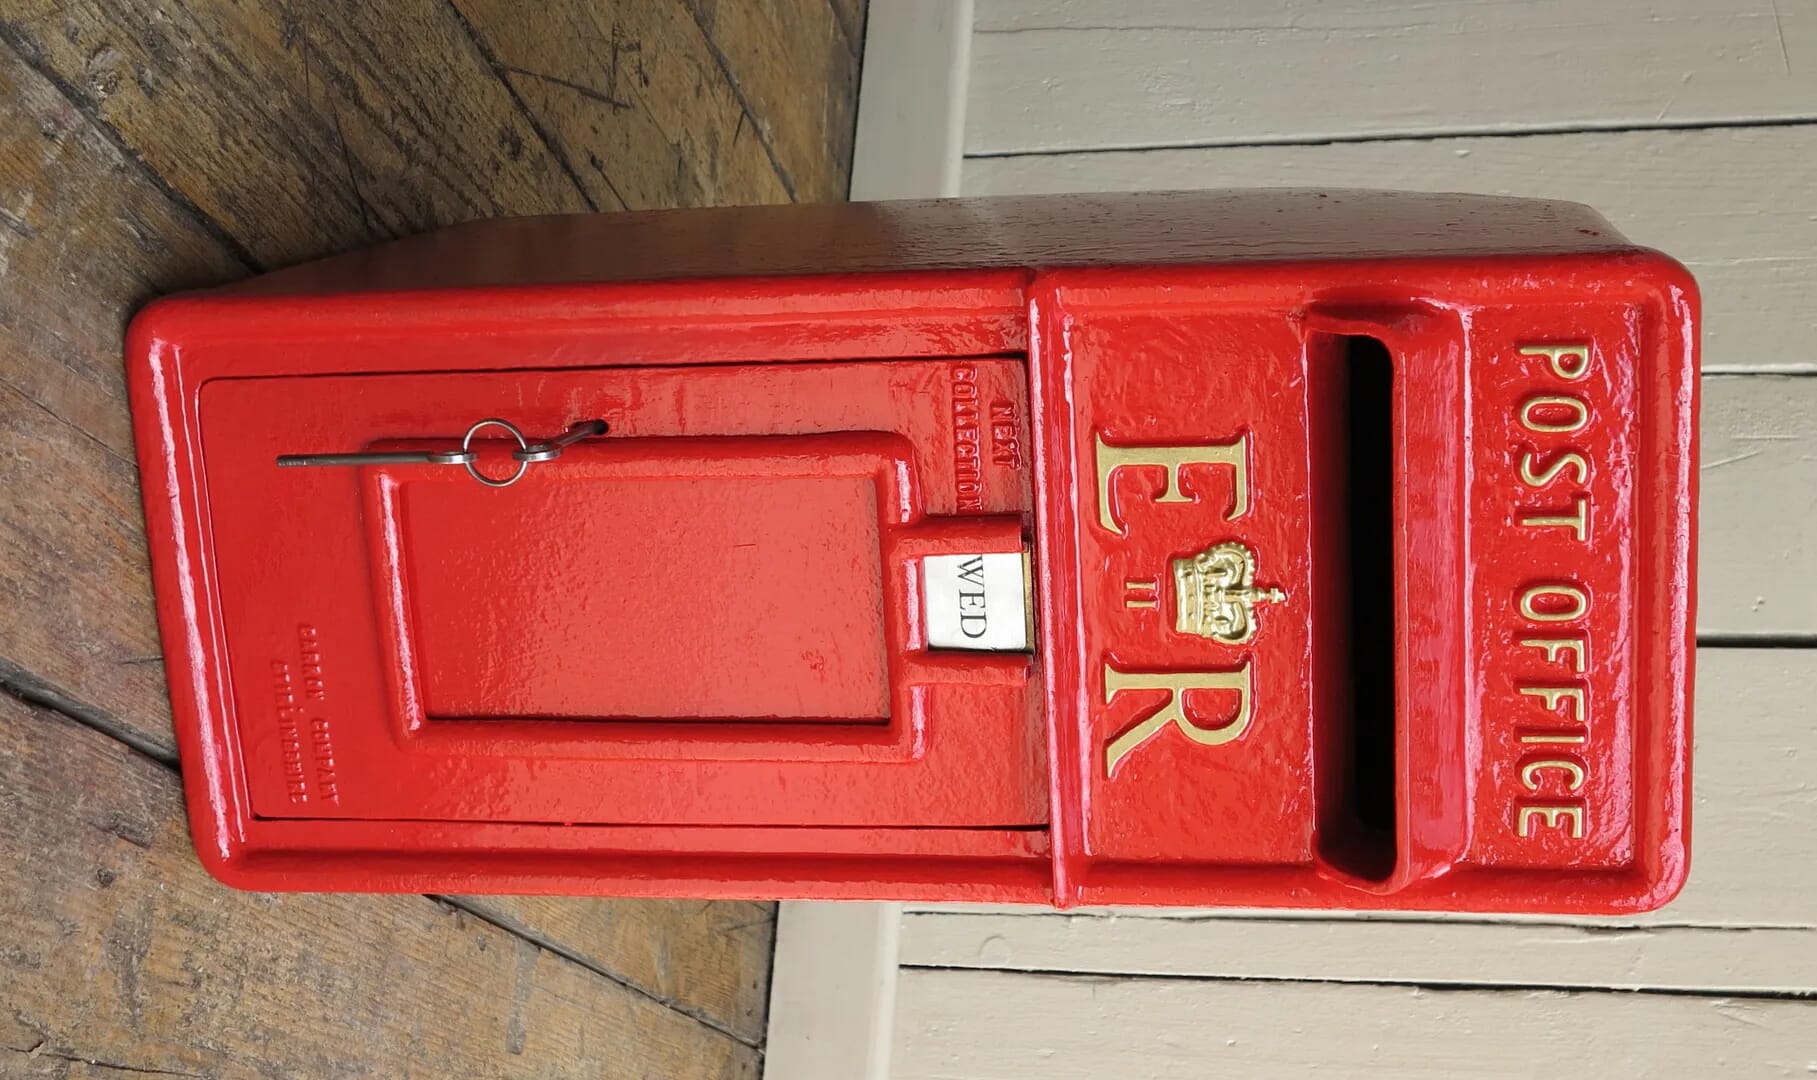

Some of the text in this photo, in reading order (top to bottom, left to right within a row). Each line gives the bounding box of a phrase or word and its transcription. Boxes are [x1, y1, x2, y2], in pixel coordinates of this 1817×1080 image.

[951, 364, 984, 512] COLLECTION
[990, 400, 1022, 470] NEXT
[957, 554, 988, 639] WED
[1096, 431, 1251, 779] E R
[1126, 582, 1156, 608] II
[1518, 344, 1590, 838] POST OFFICE
